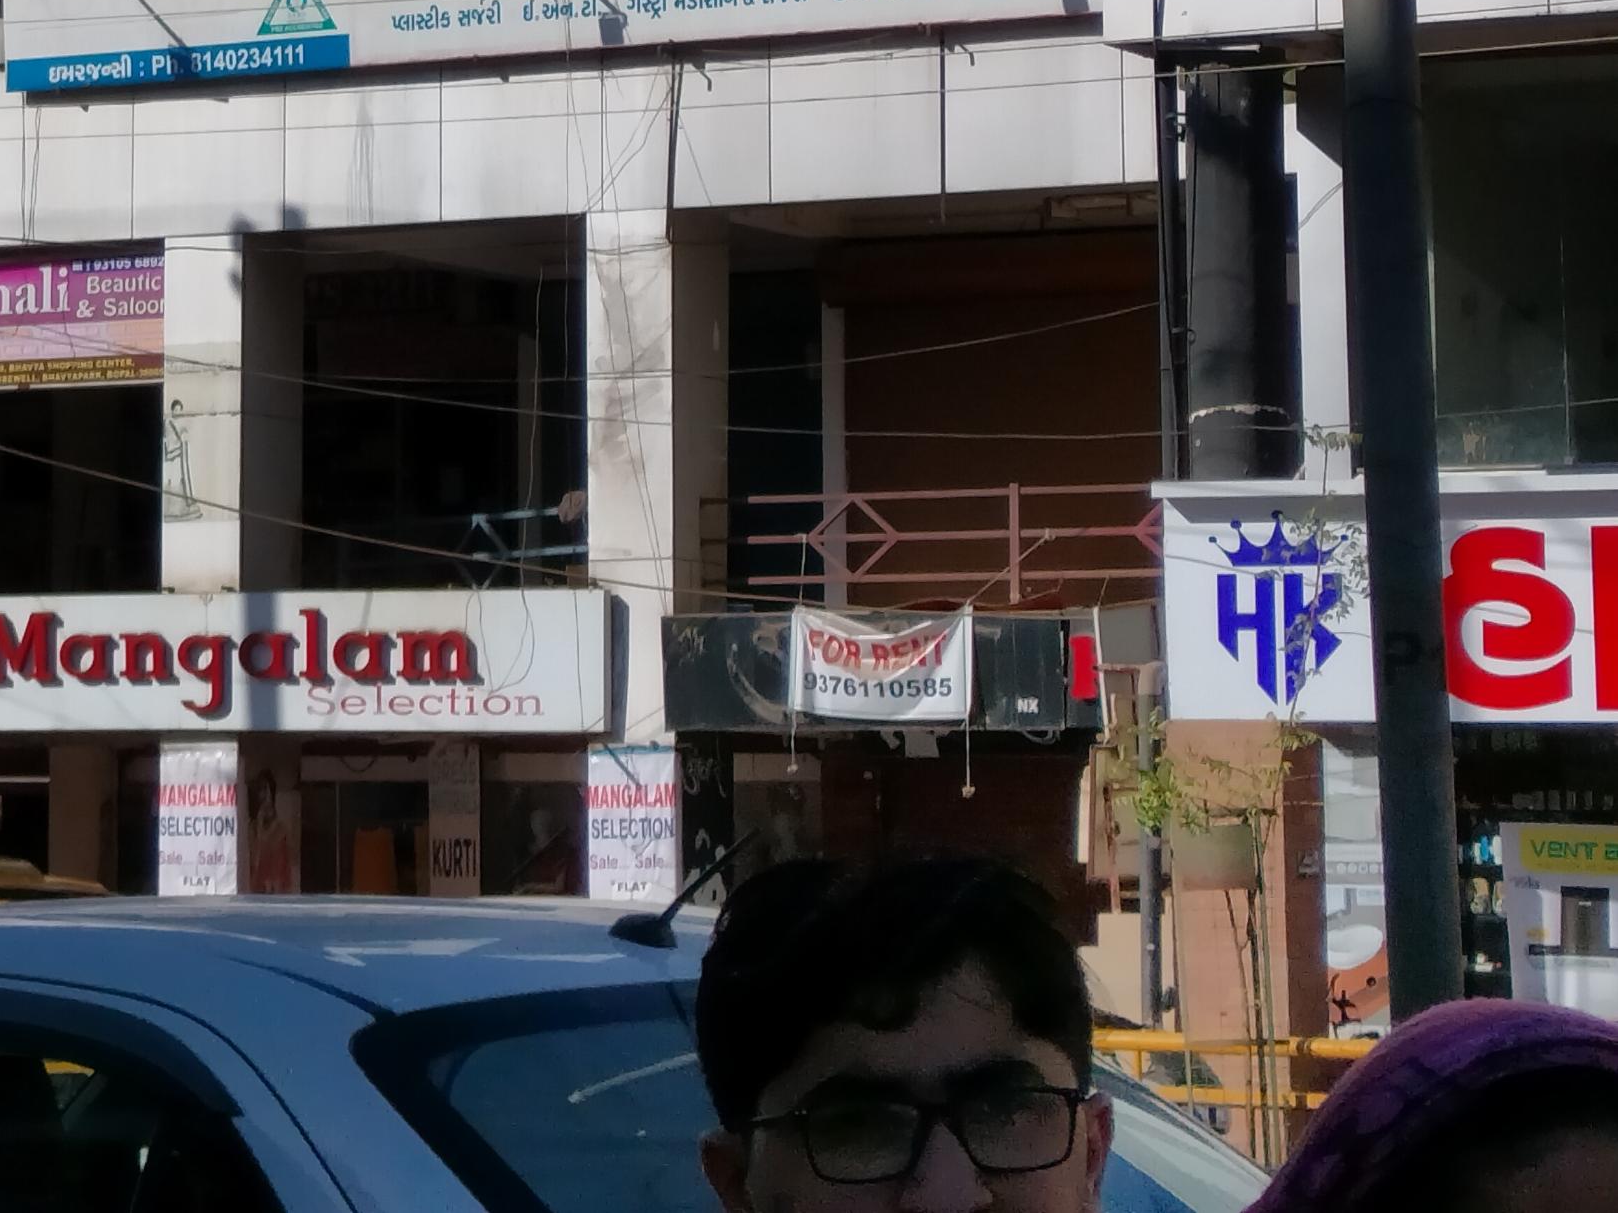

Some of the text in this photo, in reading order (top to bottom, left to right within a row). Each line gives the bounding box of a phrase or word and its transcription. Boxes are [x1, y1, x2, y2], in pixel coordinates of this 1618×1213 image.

[190, 43, 306, 73] 8140234111
[76, 298, 96, 318] &
[806, 629, 949, 672] FOR RENT
[1216, 573, 1343, 706] HK
[803, 672, 953, 699] 9376110585
[306, 685, 546, 717] Selection
[158, 784, 238, 807] MANGALAM
[584, 782, 678, 809] MANGALAM
[160, 816, 235, 837] SELECTION
[591, 816, 674, 840] SELECTION
[432, 839, 477, 879] KURTI
[183, 876, 211, 887] FLAT
[617, 881, 648, 892] FLAT
